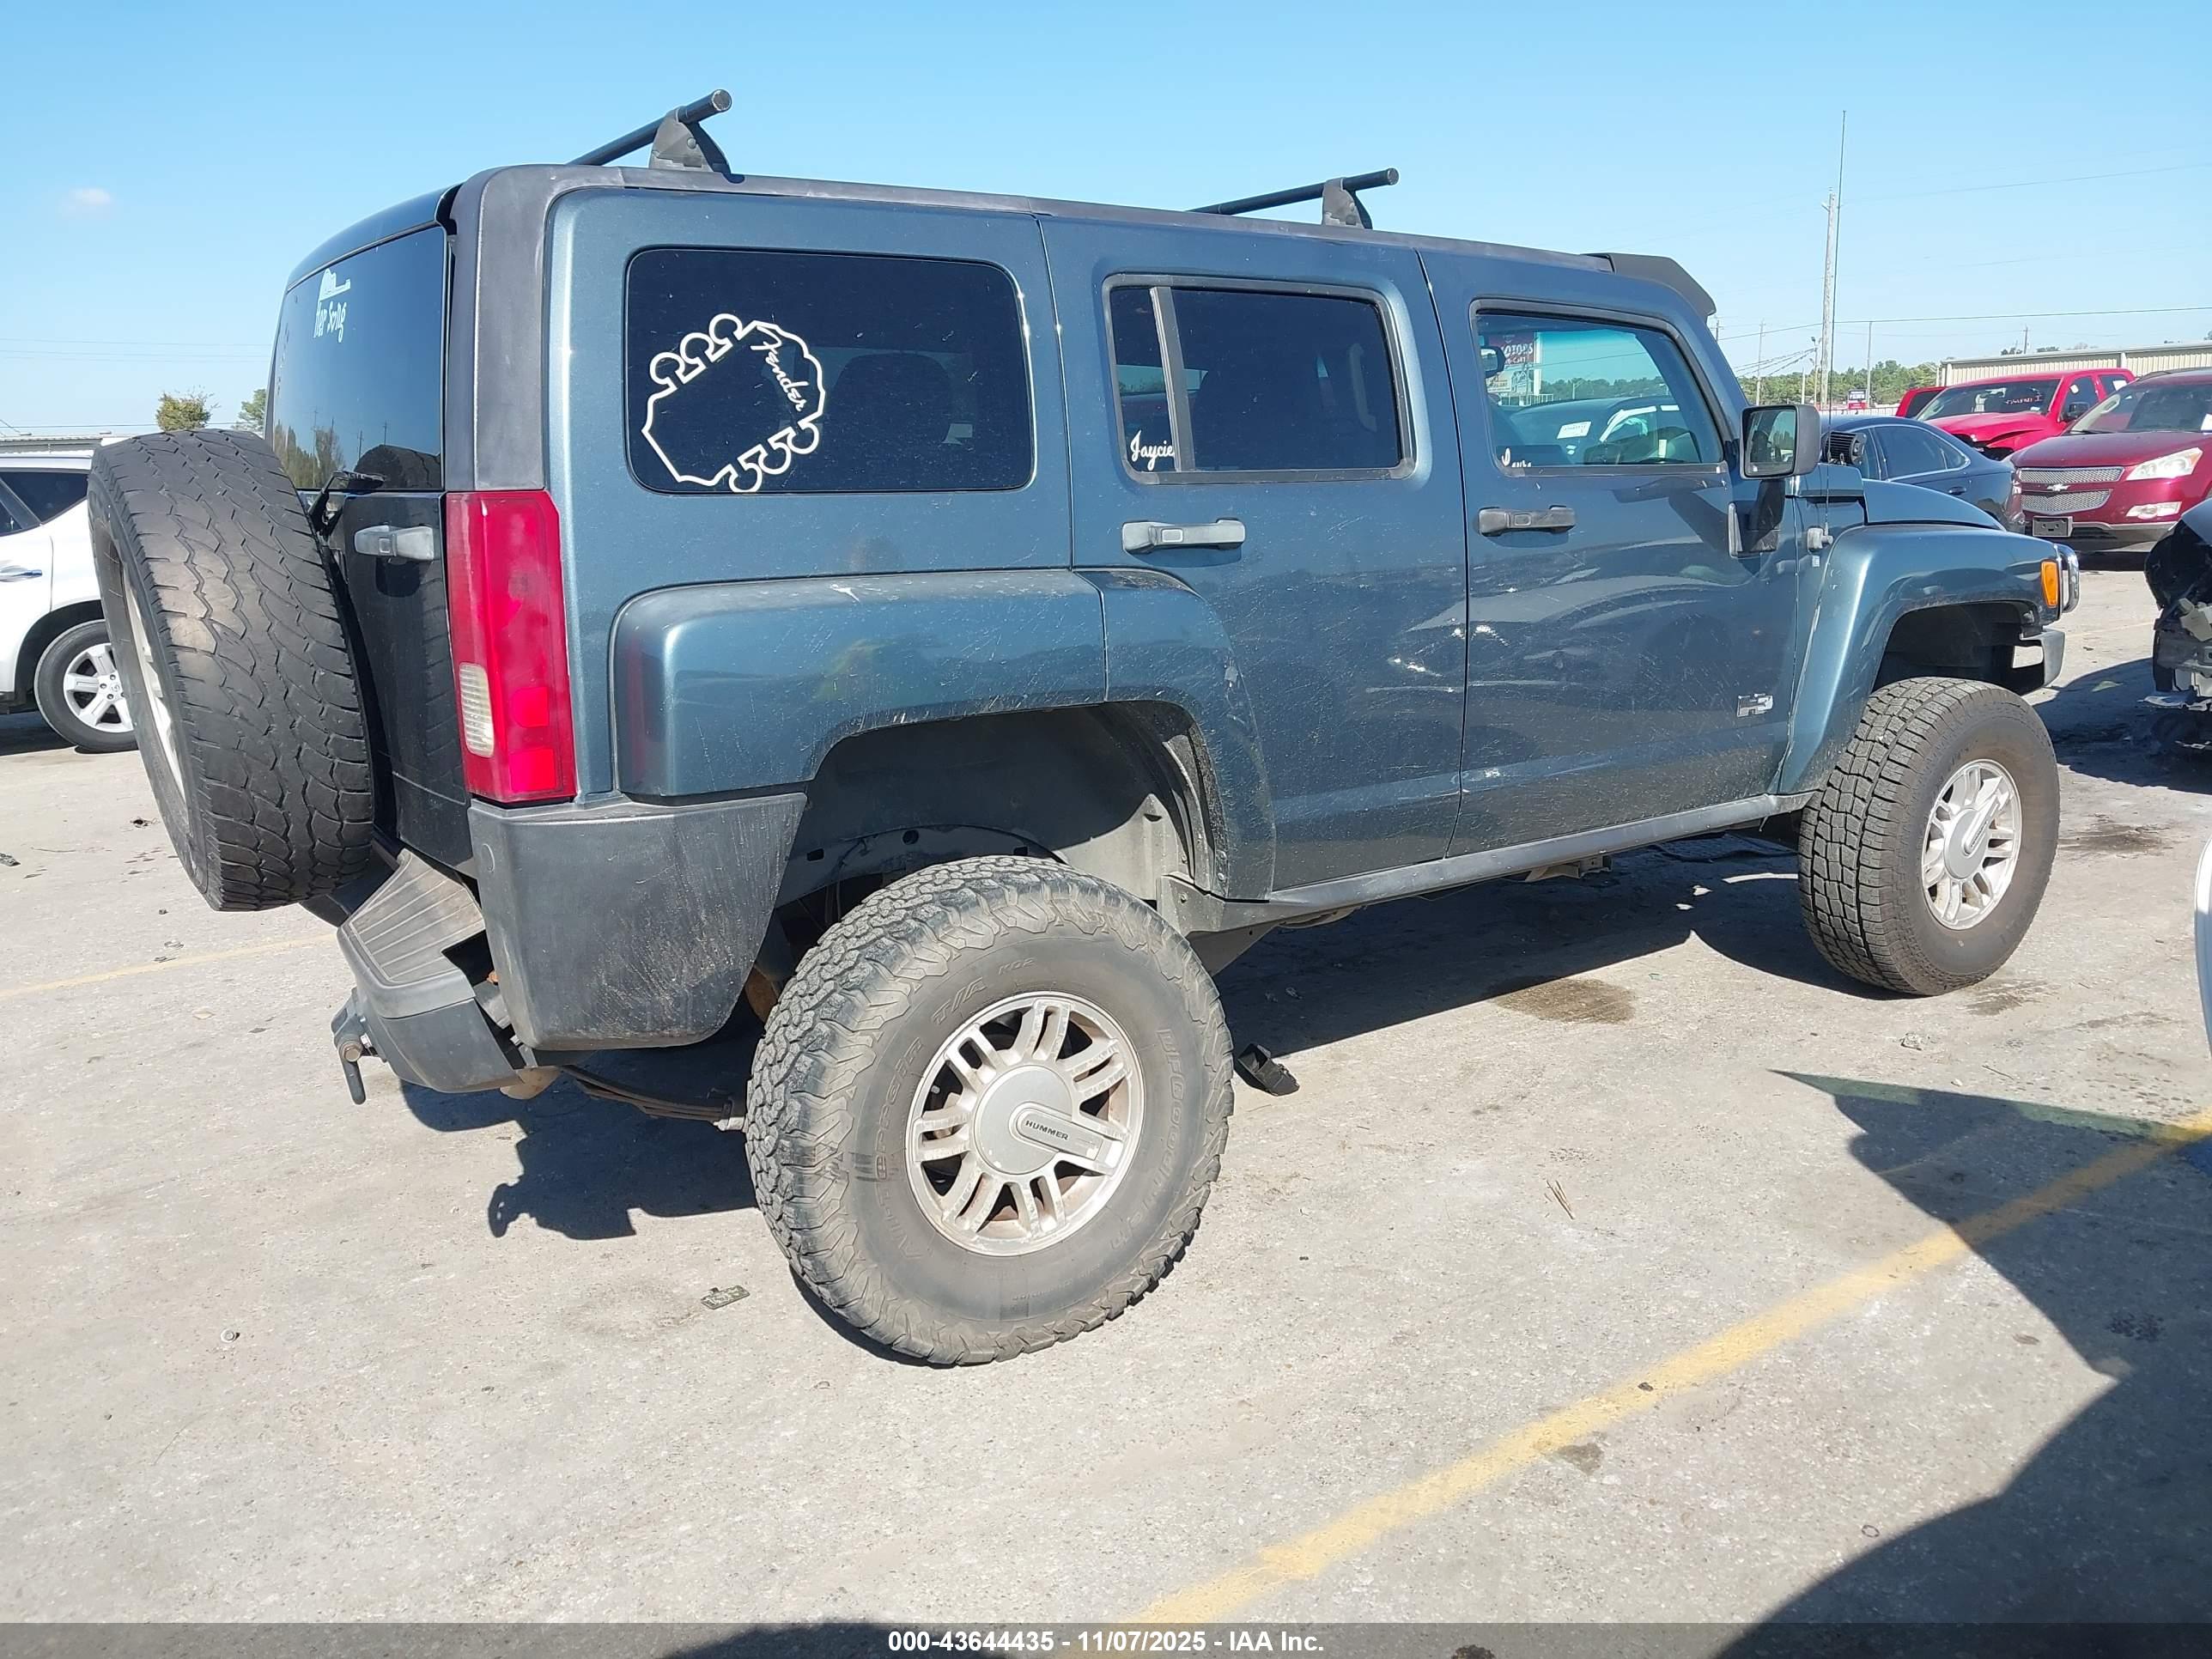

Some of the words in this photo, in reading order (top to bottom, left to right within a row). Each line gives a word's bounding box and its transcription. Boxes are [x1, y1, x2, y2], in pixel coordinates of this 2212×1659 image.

[750, 325, 809, 412] Fender
[1130, 429, 1176, 471] Jaycie
[1024, 1120, 1069, 1140] HUMMER
